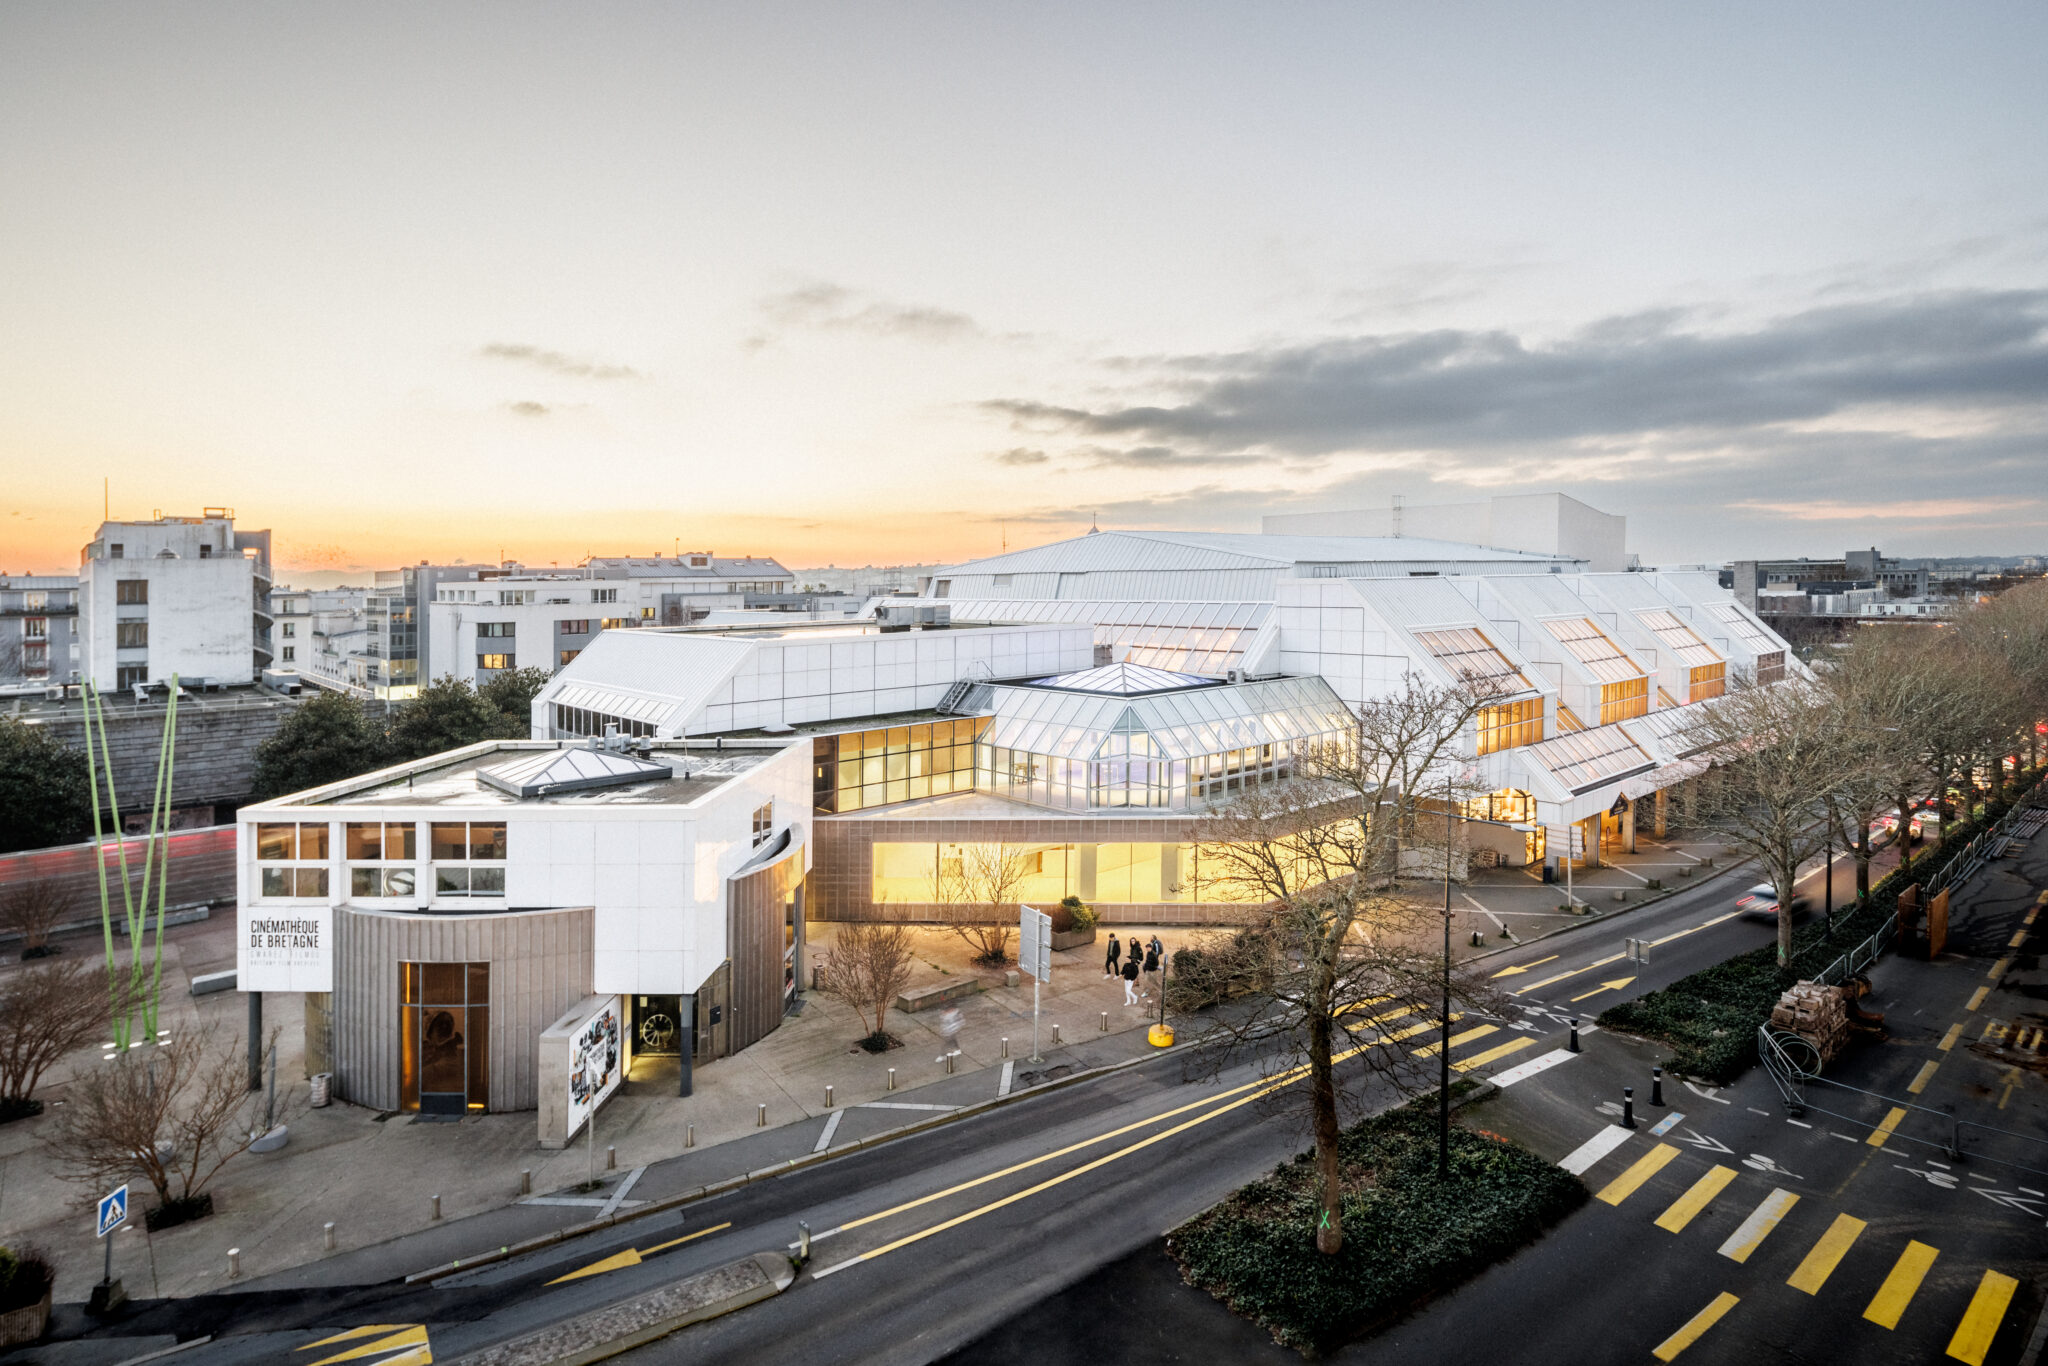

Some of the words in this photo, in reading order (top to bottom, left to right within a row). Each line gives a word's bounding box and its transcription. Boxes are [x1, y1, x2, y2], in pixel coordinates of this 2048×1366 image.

[251, 917, 319, 935] CINÉMATHÈQUE
[251, 935, 263, 948] DE
[267, 935, 319, 948] BRETAGNE
